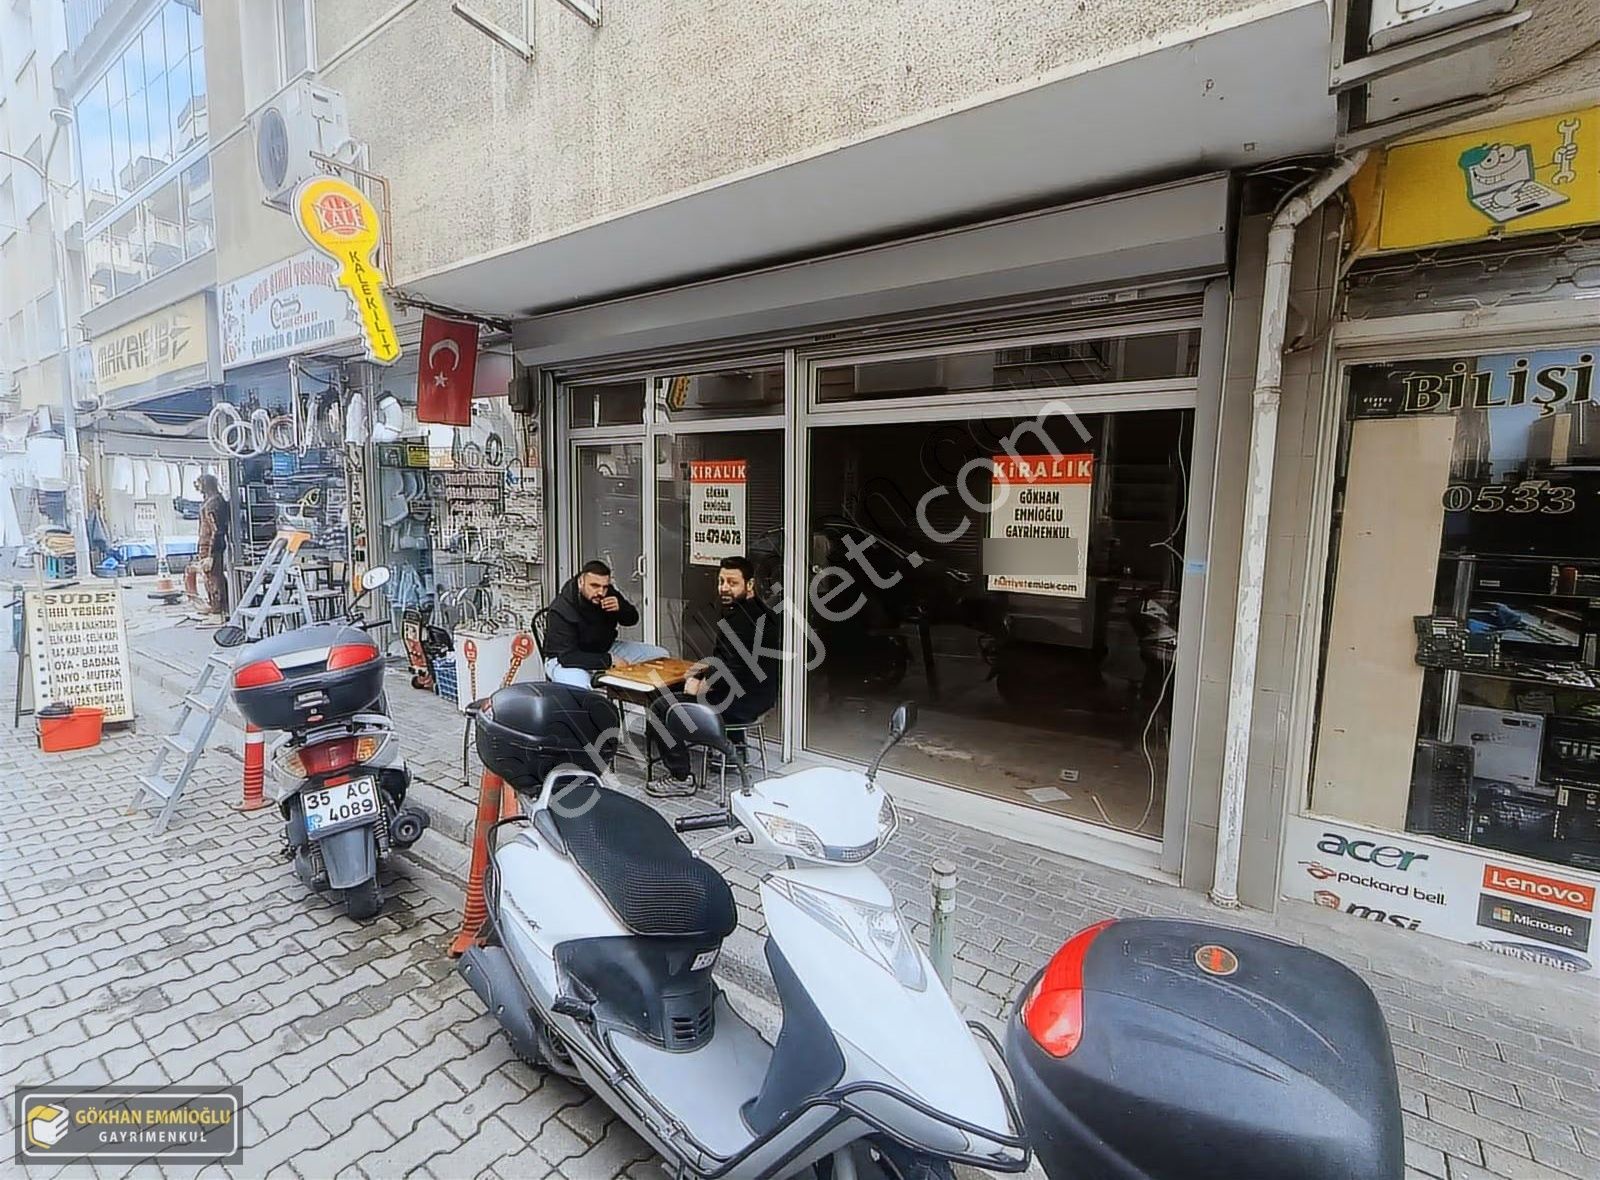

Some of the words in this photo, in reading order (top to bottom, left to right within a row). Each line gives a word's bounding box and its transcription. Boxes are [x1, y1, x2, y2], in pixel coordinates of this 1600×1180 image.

[313, 202, 369, 234] KALE
[1019, 488, 1059, 504] GÖKHAN
[1441, 485, 1576, 514] 0533
[1014, 506, 1063, 522] EMMİOĞLU
[1005, 524, 1071, 539] GAYRİMENKUL
[44, 593, 110, 605] SUDE
[82, 656, 121, 668] BADANA
[86, 669, 122, 680] MUTFAK
[63, 685, 93, 696] KAÇAK
[306, 791, 331, 810] 35
[346, 781, 371, 799] AC
[329, 799, 374, 822] 4089
[1316, 832, 1429, 872] acer
[1337, 871, 1409, 897] packard
[1491, 871, 1586, 905] Lenovo
[1513, 912, 1574, 937] Microsoft
